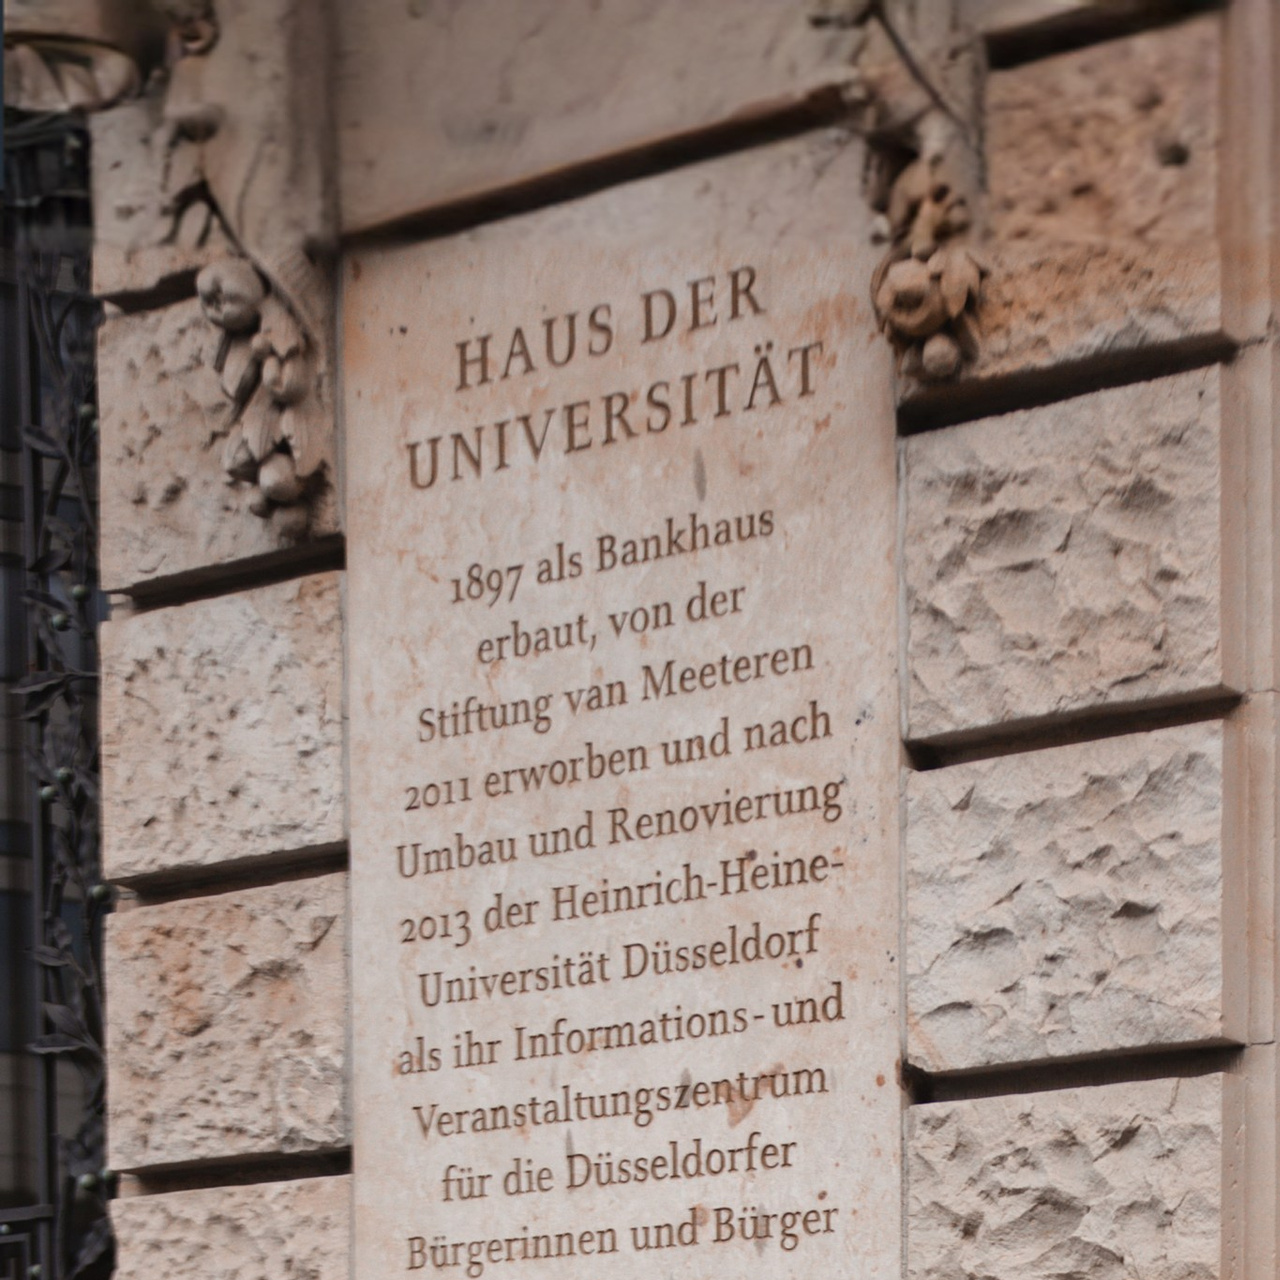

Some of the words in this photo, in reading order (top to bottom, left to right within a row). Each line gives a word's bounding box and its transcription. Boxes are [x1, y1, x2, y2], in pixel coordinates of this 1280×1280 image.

[454, 303, 615, 394] HAUS
[639, 264, 767, 346] DER
[406, 340, 825, 491] UNIVERSITÄT
[450, 563, 524, 608] 1897
[536, 543, 583, 587] als
[596, 506, 775, 574] Bankhaus
[477, 613, 597, 664] erbaut,
[608, 598, 675, 637] von
[686, 580, 747, 621] der
[418, 693, 553, 745] Stiftung
[565, 679, 628, 715] van
[641, 642, 815, 701] Meeteren
[404, 775, 472, 812] 2011
[484, 742, 649, 799] erworben
[661, 718, 732, 765] und
[743, 700, 833, 753] nach
[397, 834, 518, 879] Umbau
[529, 811, 597, 858] und
[607, 778, 844, 846] Renovierung
[400, 913, 472, 948] 2013
[483, 893, 540, 934] der
[551, 854, 845, 923] Heinrich-Heine-
[419, 950, 611, 1007] Universität
[622, 913, 821, 980] Düsseldorf
[398, 1034, 442, 1075] als
[453, 1030, 502, 1069] ihr
[772, 982, 846, 1026] und
[412, 1065, 829, 1140] Veranstaltungszentrum
[441, 1165, 492, 1202] für
[503, 1158, 554, 1197] die
[566, 1132, 797, 1191] Düsseldorfer
[406, 1224, 619, 1278] Bürgerinnen
[631, 1203, 700, 1251] und
[711, 1200, 839, 1252] Bürger
